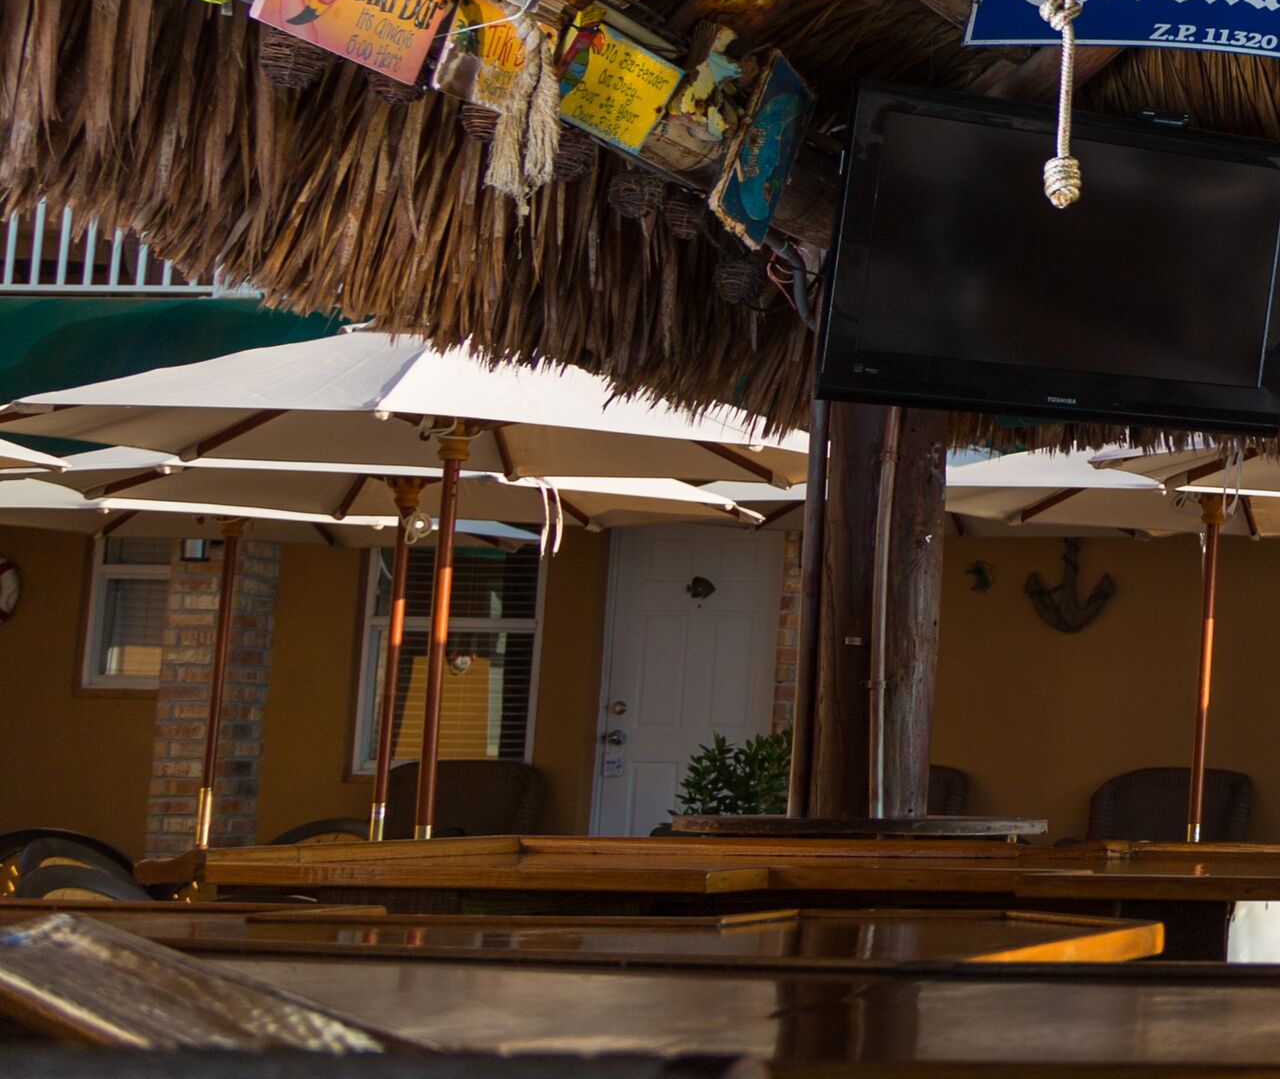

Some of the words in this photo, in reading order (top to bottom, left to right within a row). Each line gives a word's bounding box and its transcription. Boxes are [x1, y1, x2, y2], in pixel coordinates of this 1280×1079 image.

[1149, 23, 1196, 43] Z.P.
[1203, 28, 1279, 49] 11320
[601, 43, 618, 63] No
